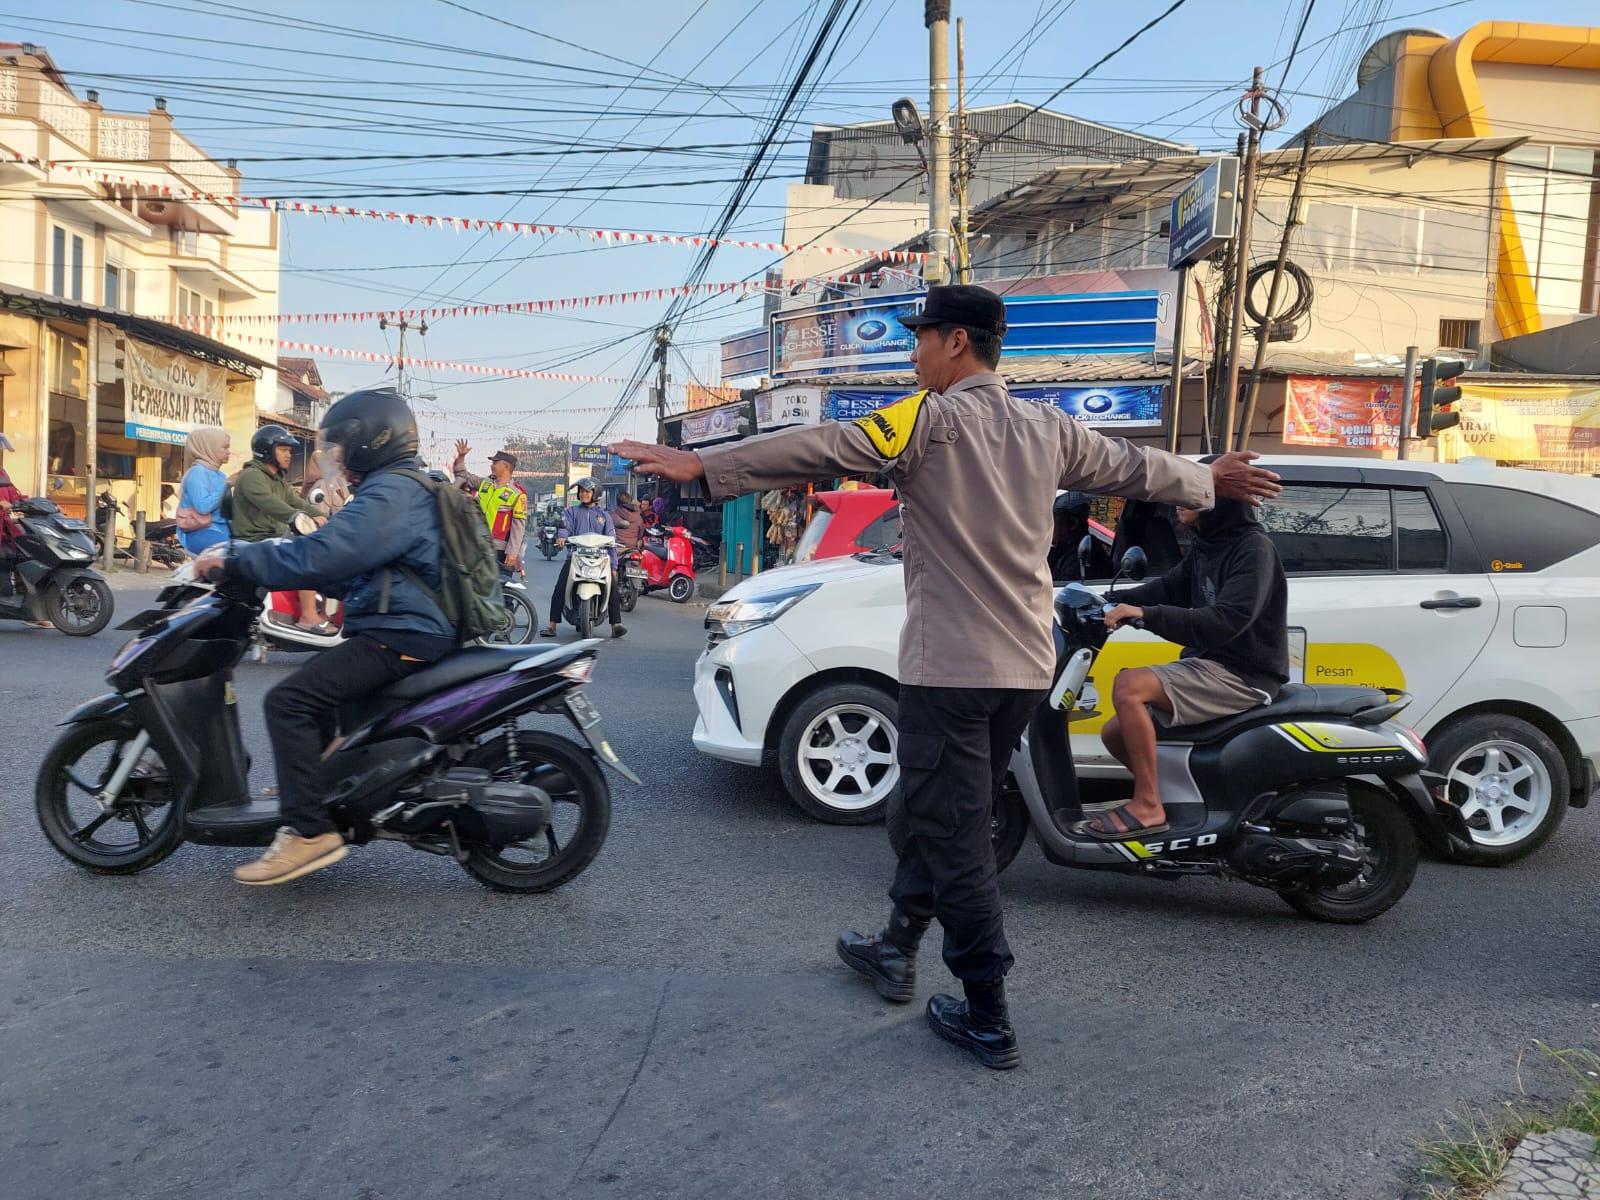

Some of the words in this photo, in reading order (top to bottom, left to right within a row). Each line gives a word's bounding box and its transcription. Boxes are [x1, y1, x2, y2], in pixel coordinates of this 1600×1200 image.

[801, 323, 838, 340] ESSE
[786, 336, 838, 351] CHANGE
[873, 338, 909, 349] CHANGE
[166, 364, 197, 388] TOKO
[784, 394, 808, 405] TOKO
[193, 397, 223, 427] PERAK
[1463, 431, 1496, 445] LUXE
[1315, 665, 1354, 677] Pesan
[1336, 755, 1406, 764] SCOOPY
